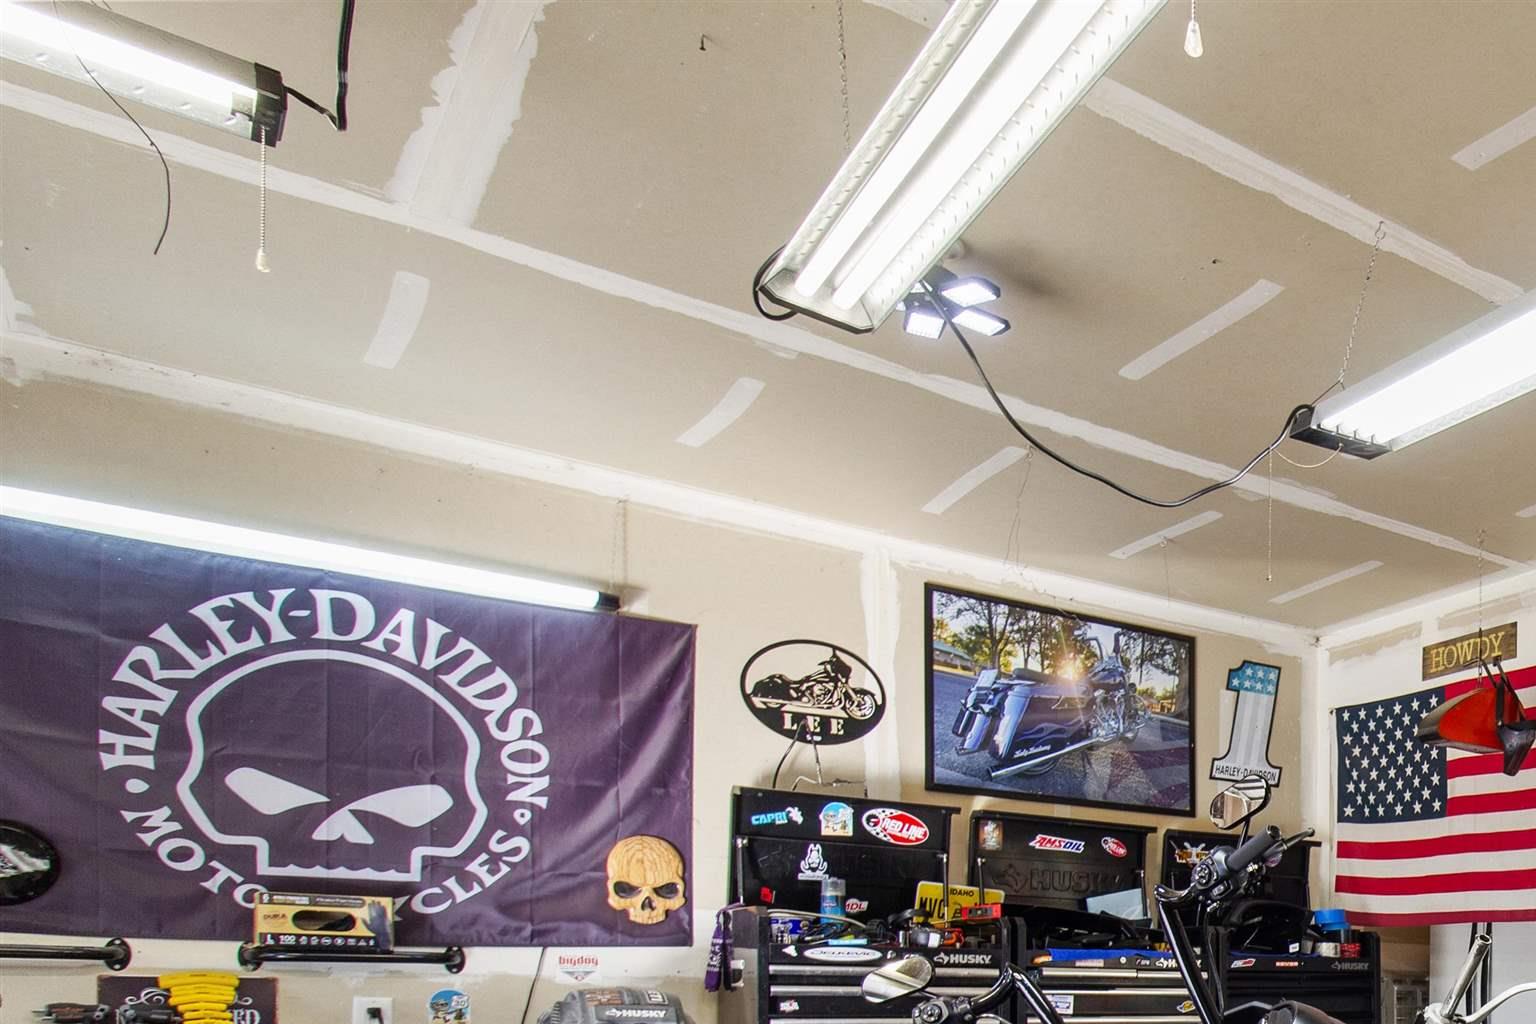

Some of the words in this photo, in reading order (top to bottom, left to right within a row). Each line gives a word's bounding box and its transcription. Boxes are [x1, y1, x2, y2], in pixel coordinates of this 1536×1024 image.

[1430, 631, 1504, 673] HOWDY
[98, 587, 552, 811] HARLEY-DAVIDSON
[881, 818, 904, 833] RED
[1031, 836, 1085, 852] AMSOIL
[950, 953, 992, 965] HUSKY
[1341, 961, 1369, 970] HUSKY
[623, 1009, 666, 1019] HUSKY
